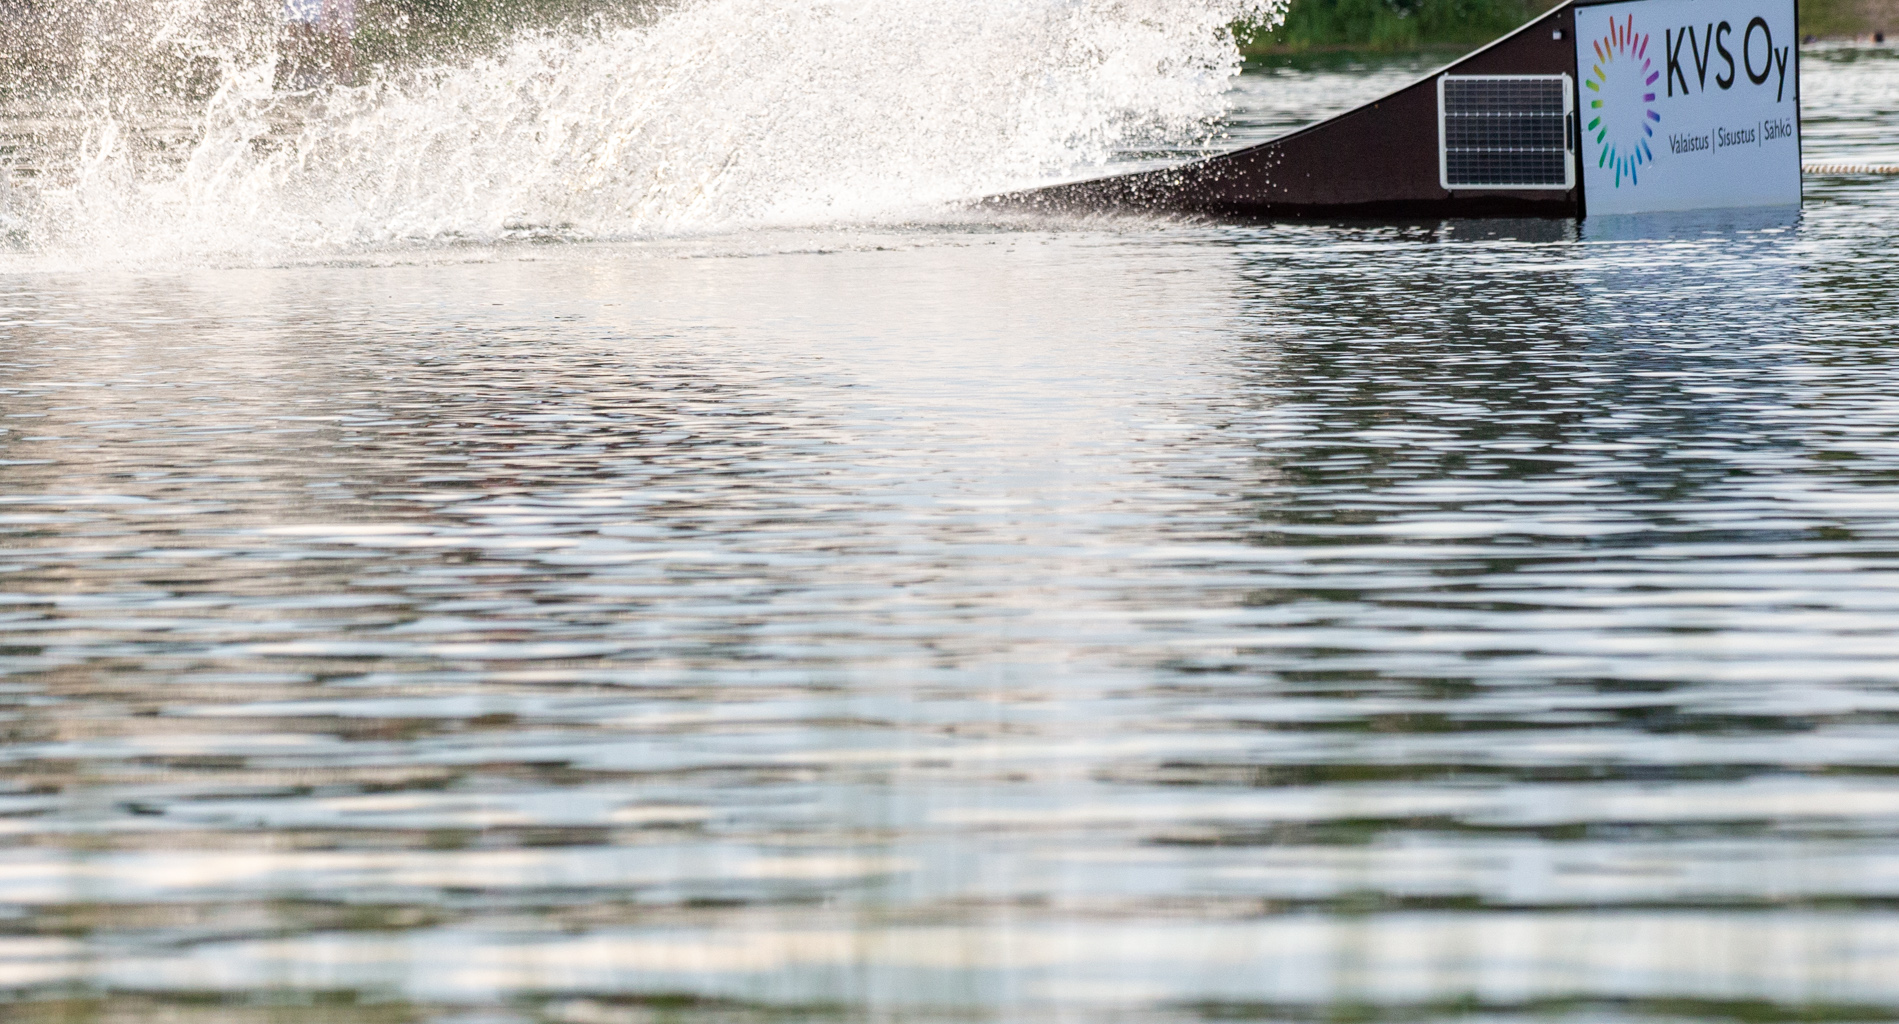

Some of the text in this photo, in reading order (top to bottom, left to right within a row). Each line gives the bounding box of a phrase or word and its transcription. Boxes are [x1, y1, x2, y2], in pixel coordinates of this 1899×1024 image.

[1666, 16, 1788, 103] KVS Oy
[1668, 118, 1792, 154] Valaistus Sisustus Sähkö
